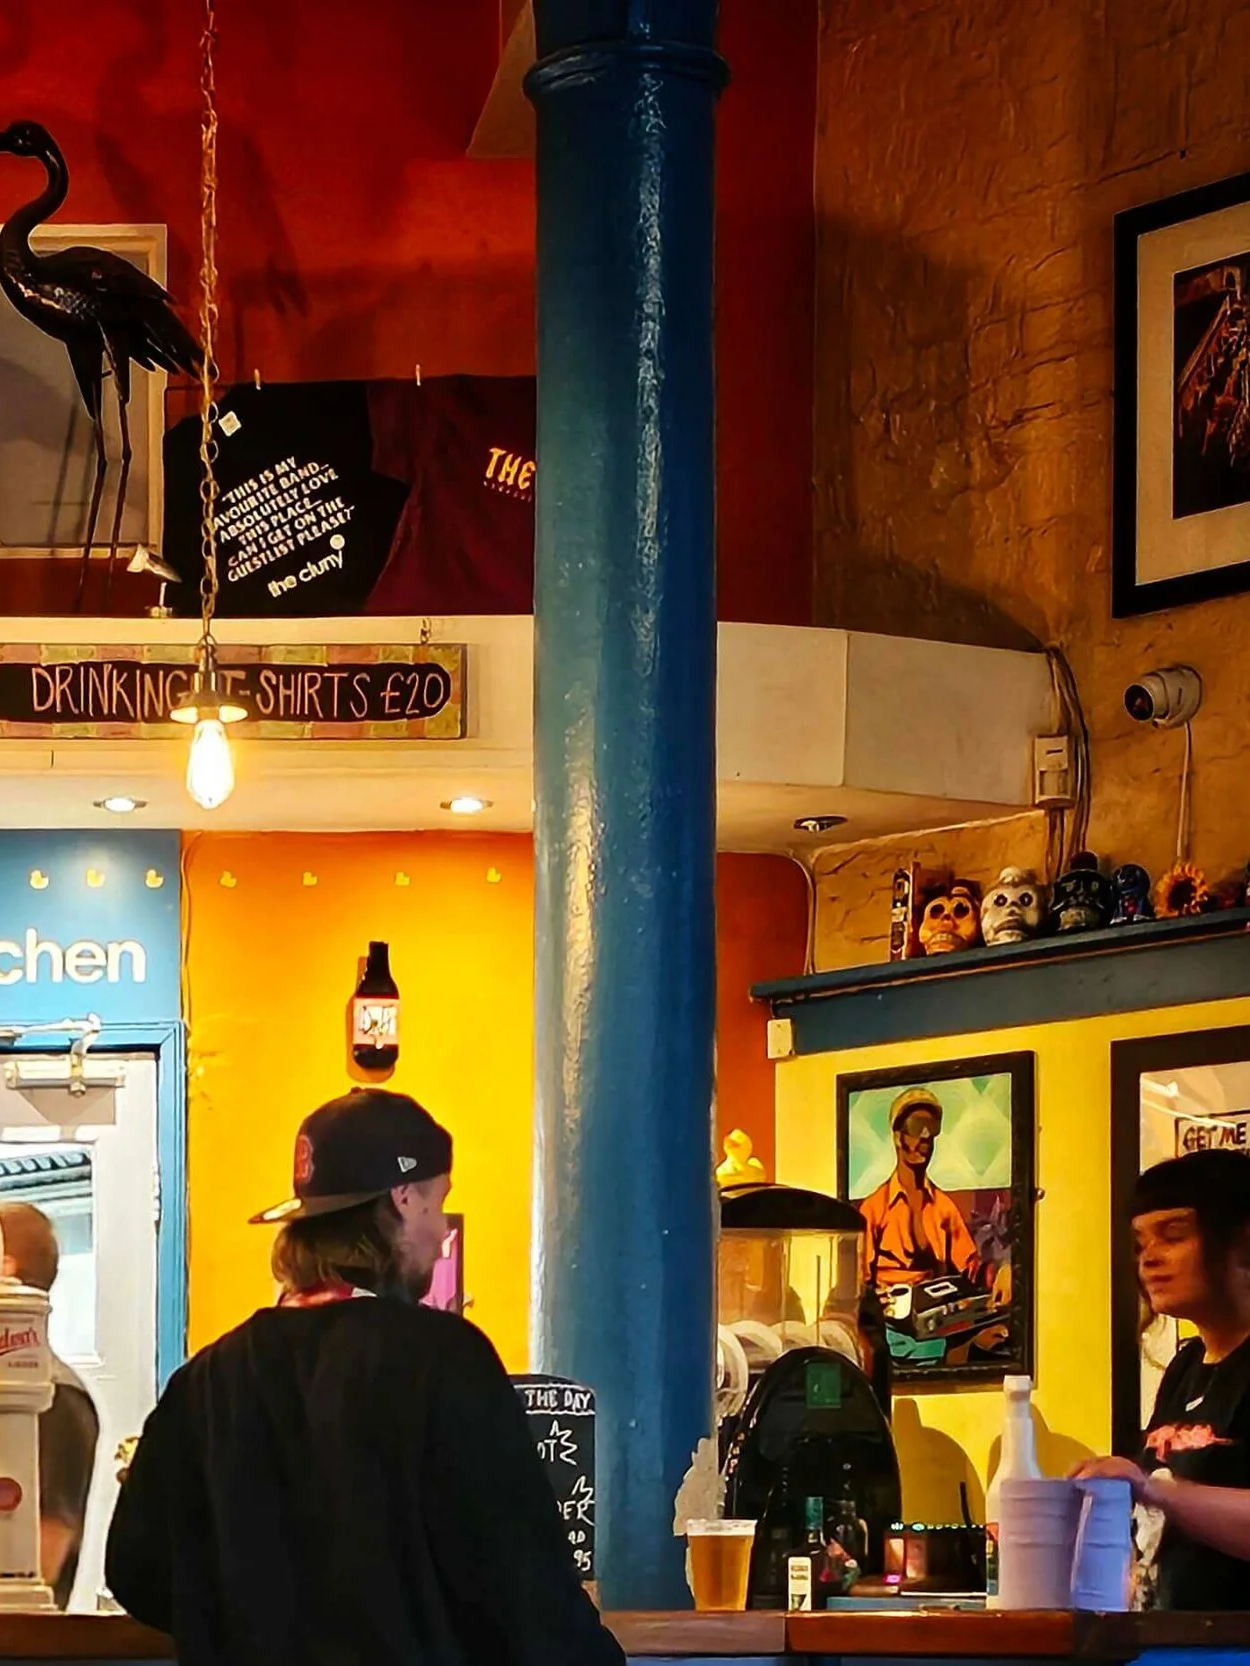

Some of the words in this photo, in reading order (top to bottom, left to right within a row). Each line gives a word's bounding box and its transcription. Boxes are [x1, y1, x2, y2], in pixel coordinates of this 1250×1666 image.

[274, 456, 297, 475] MY
[485, 447, 536, 490] THE
[211, 482, 279, 532] AVOURITE
[219, 487, 300, 543] ABSOLUTELY
[300, 467, 340, 495] LOVE
[227, 541, 259, 567] CAN
[267, 523, 293, 545] GET
[293, 511, 317, 530] ON
[316, 495, 346, 518] THE
[238, 520, 270, 546] THIS
[227, 538, 296, 583] GUESTLIST
[267, 574, 298, 598] the
[298, 549, 344, 583] cluny
[31, 662, 189, 721] DRINKING
[380, 671, 445, 715] £20
[1182, 1125, 1218, 1151] GET
[1217, 1121, 1248, 1148] ME
[524, 1388, 558, 1408] THE
[563, 1389, 592, 1412] DAY
